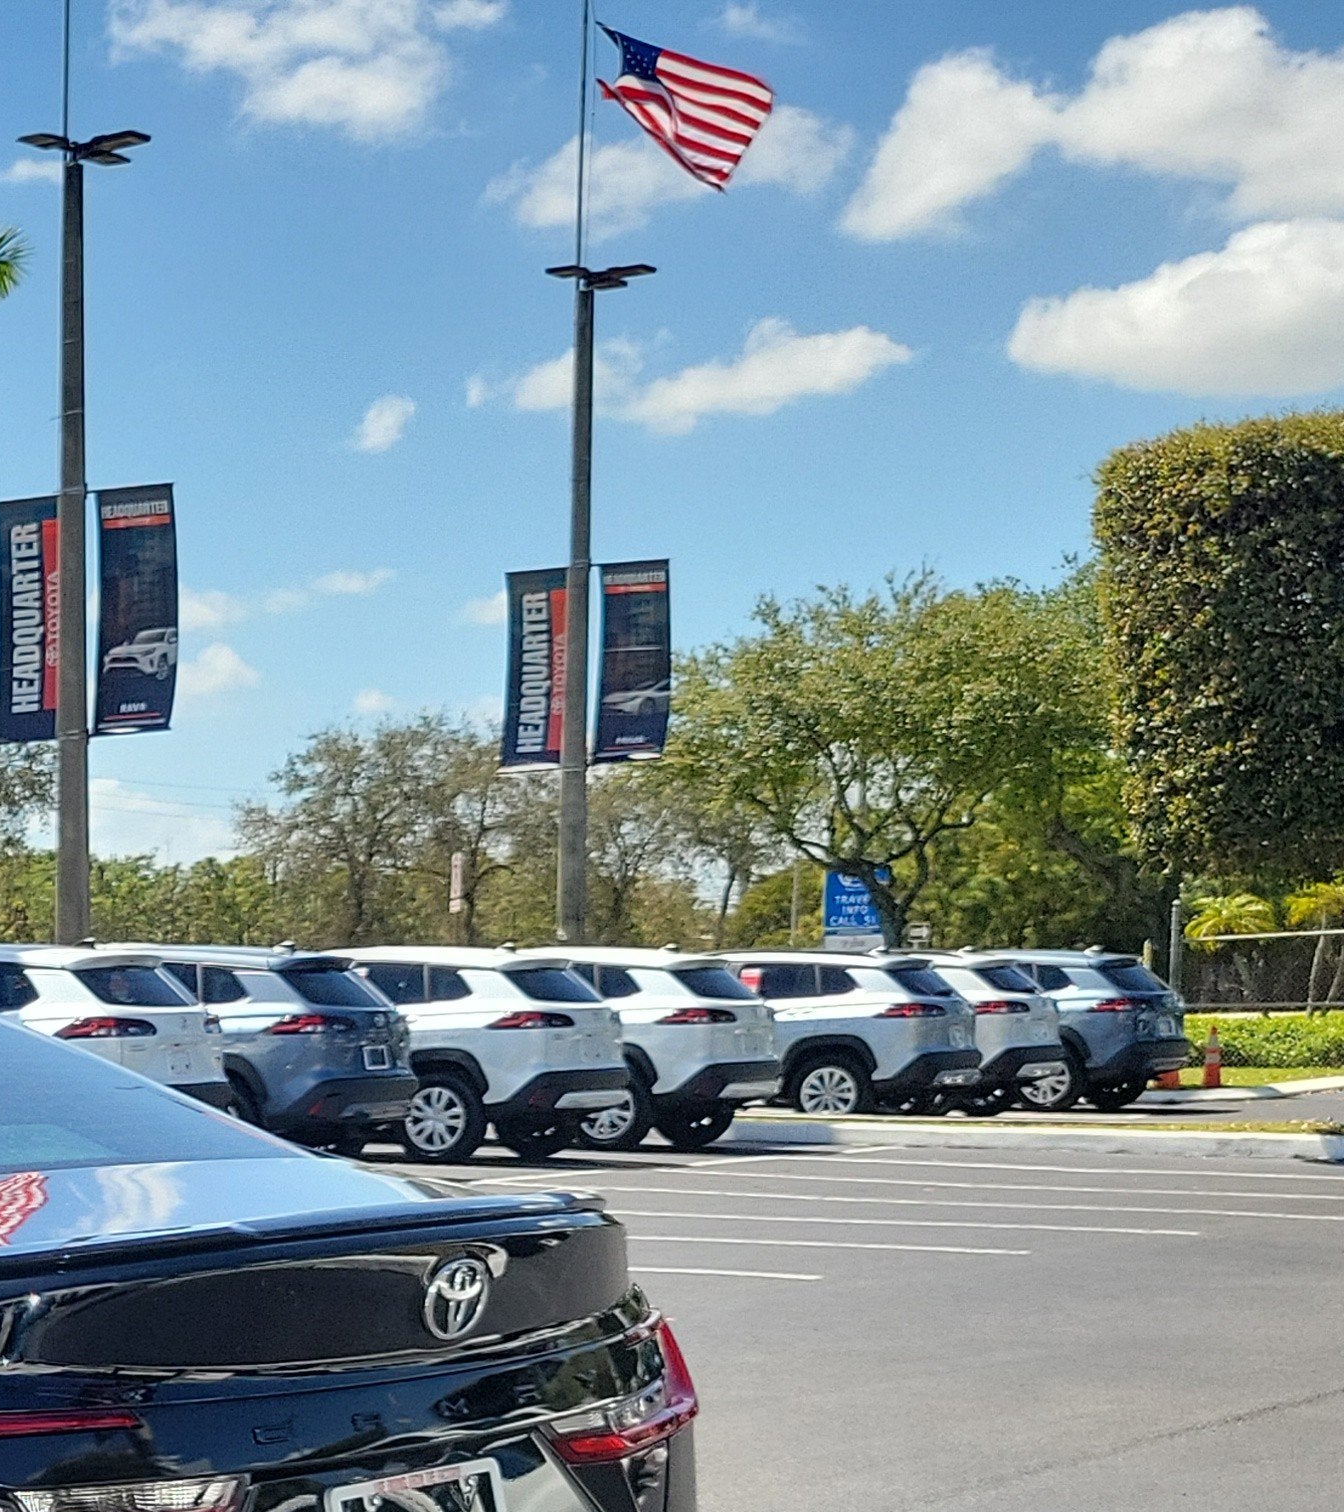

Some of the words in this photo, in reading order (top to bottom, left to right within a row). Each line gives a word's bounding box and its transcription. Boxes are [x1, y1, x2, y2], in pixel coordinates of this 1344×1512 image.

[11, 521, 44, 714] HEADQUARTER
[515, 591, 551, 753] HEADQUARTER
[830, 914, 858, 926] CALL
[834, 893, 871, 905] TRAVE
